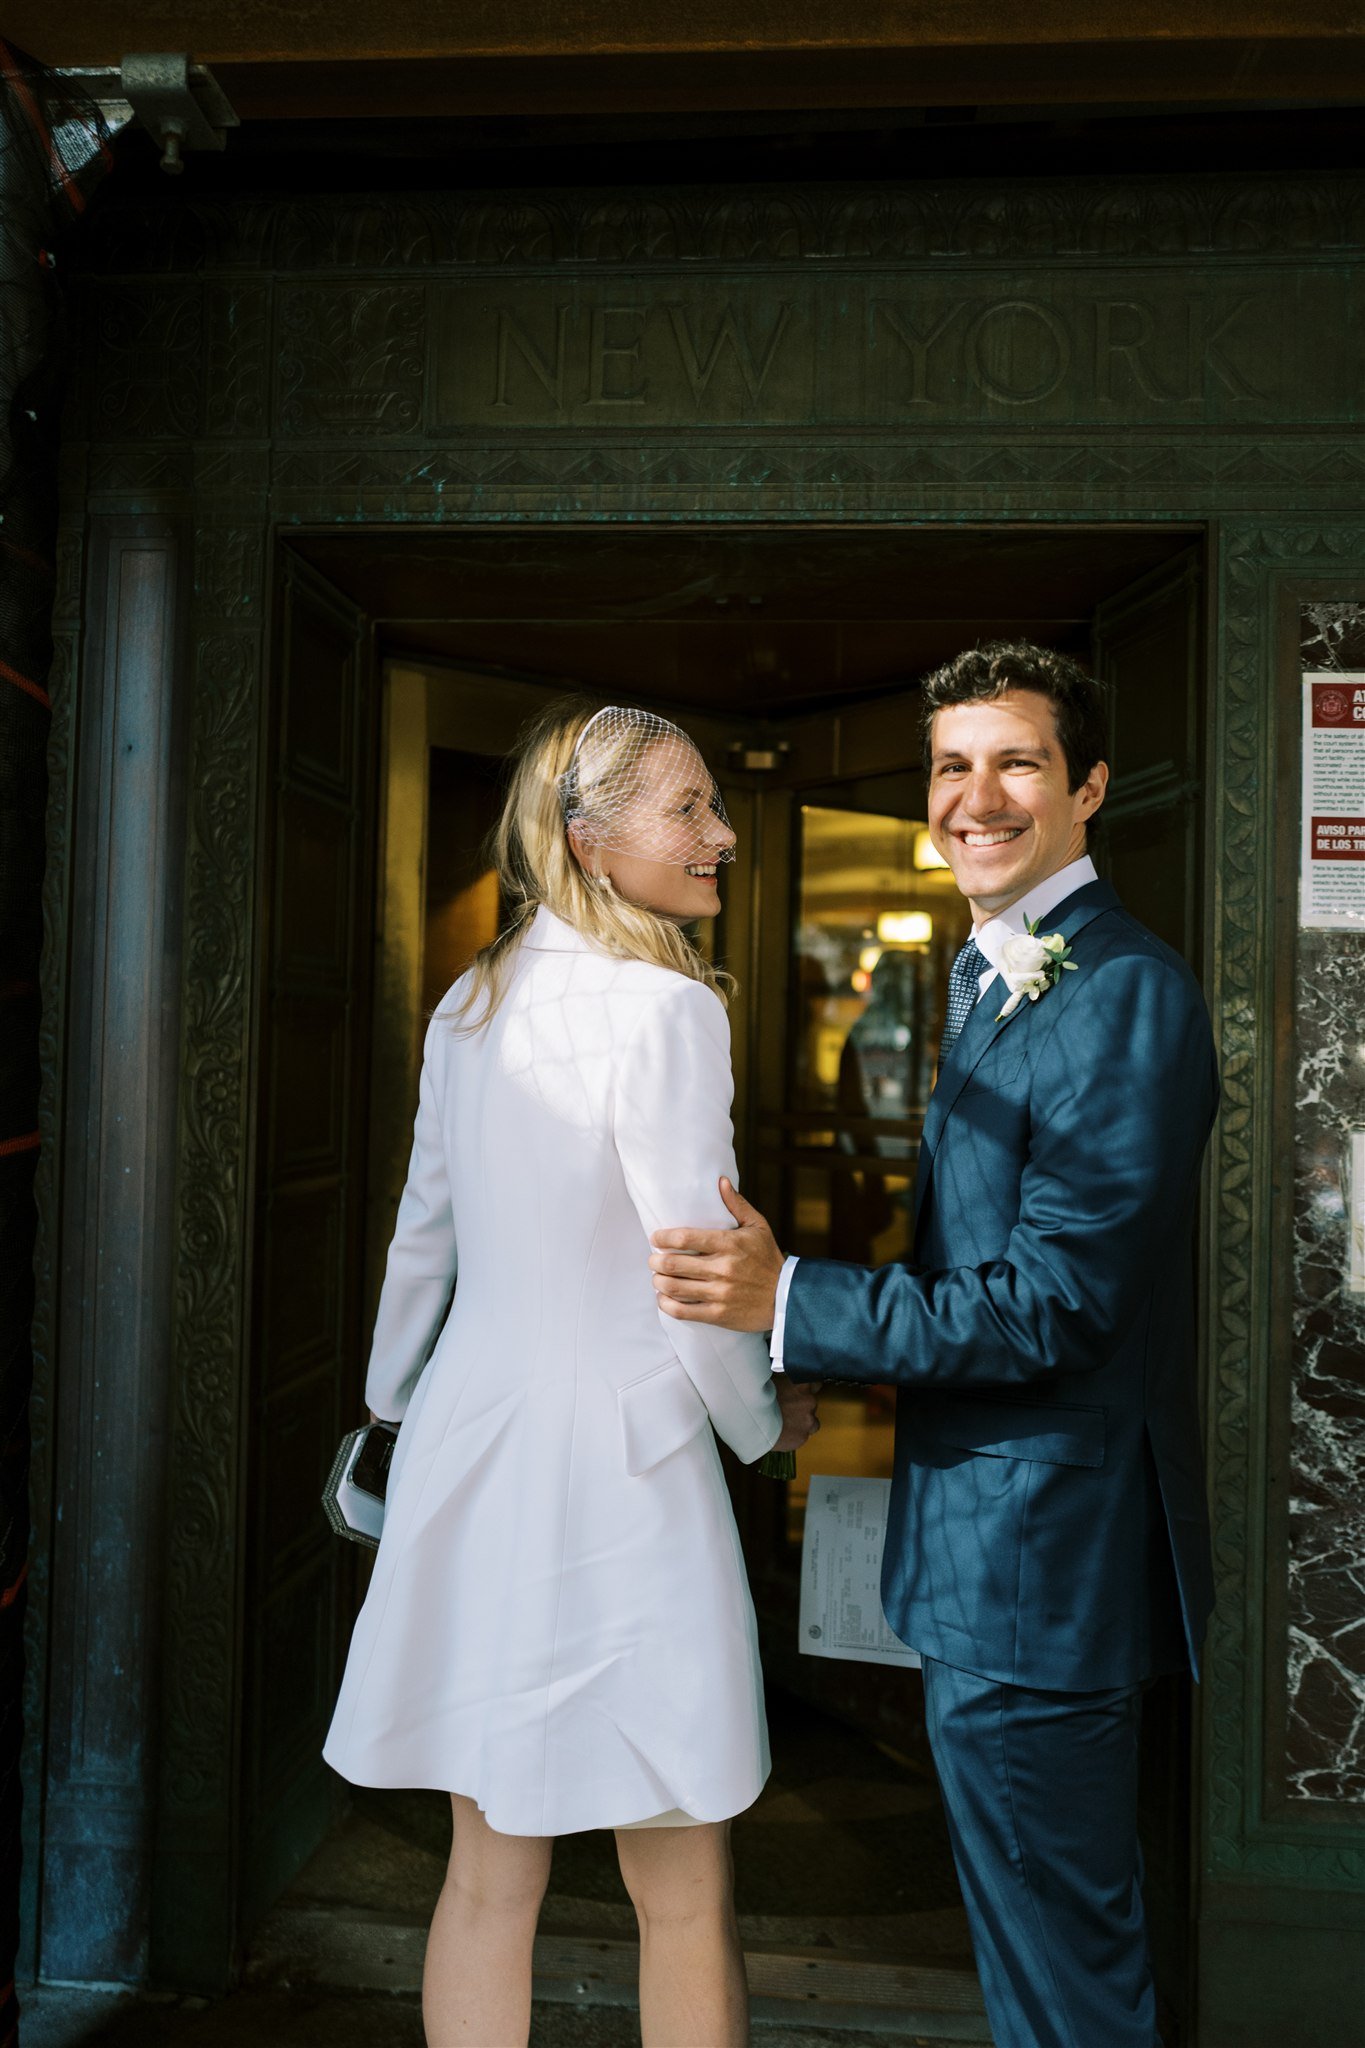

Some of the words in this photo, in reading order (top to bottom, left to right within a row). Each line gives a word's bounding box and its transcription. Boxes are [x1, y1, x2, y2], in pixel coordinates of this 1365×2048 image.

[486, 303, 797, 409] NEW
[869, 293, 1269, 406] YORK
[1317, 825, 1345, 835] AVISO
[1317, 839, 1330, 849] DE
[1332, 840, 1351, 849] LOS
